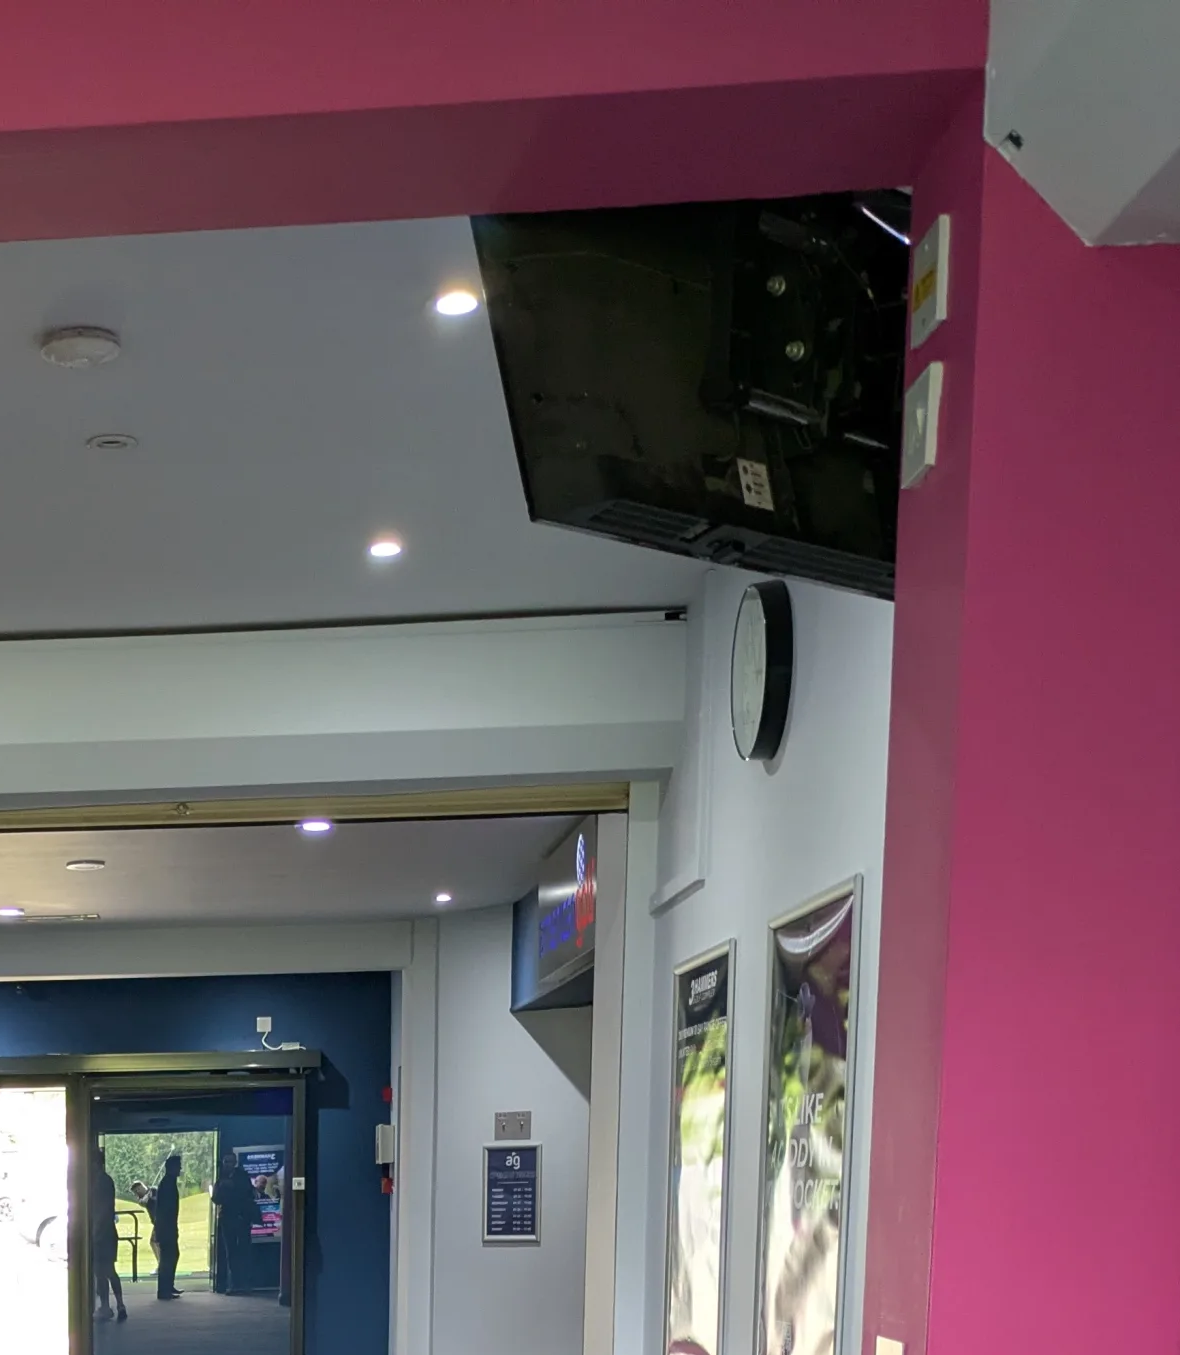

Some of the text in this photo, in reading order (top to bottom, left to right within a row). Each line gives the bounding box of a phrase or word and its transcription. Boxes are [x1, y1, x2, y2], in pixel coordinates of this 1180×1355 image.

[688, 969, 718, 1006] 3 HAMMERS
[794, 1093, 824, 1125] LIKE
[505, 1153, 521, 1170] ag
[778, 1138, 816, 1168] CDDY
[792, 1179, 839, 1210] OCKET.
